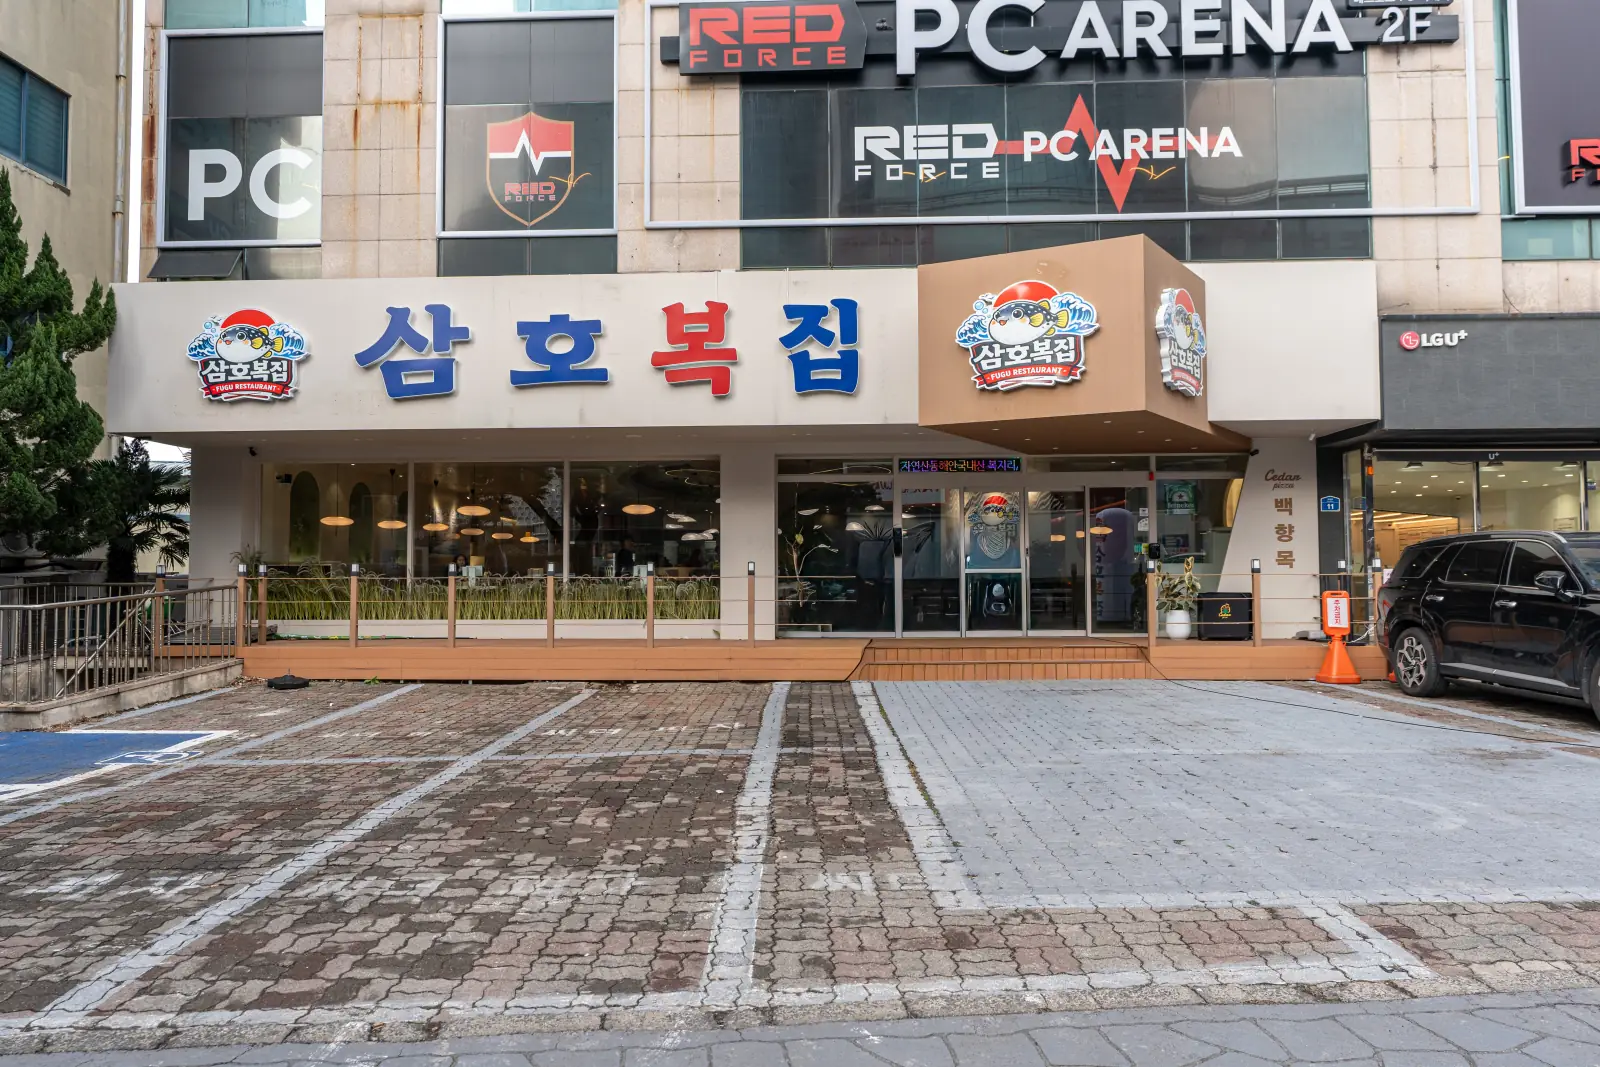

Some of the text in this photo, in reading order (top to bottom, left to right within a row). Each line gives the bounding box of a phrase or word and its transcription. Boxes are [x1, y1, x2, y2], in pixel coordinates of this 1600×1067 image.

[689, 4, 845, 47] RED
[895, 0, 1354, 76] PC ARENA
[1382, 7, 1432, 42] 2F
[690, 46, 846, 68] FORCE
[854, 123, 998, 161] RED
[1023, 127, 1243, 162] PC ARENA
[188, 149, 312, 220] PC
[505, 182, 555, 195] RED
[855, 161, 999, 181] FORCE
[354, 298, 859, 399] 삼호복집
[974, 336, 1075, 371] 삼호복집
[202, 360, 288, 382] 삼호복집
[236, 383, 276, 392] RESTAURANT
[991, 366, 1063, 381] FUGU RESTAURANT
[1265, 469, 1302, 481] Cedar
[1272, 482, 1295, 491] pizza
[1274, 497, 1295, 569] 백향목
